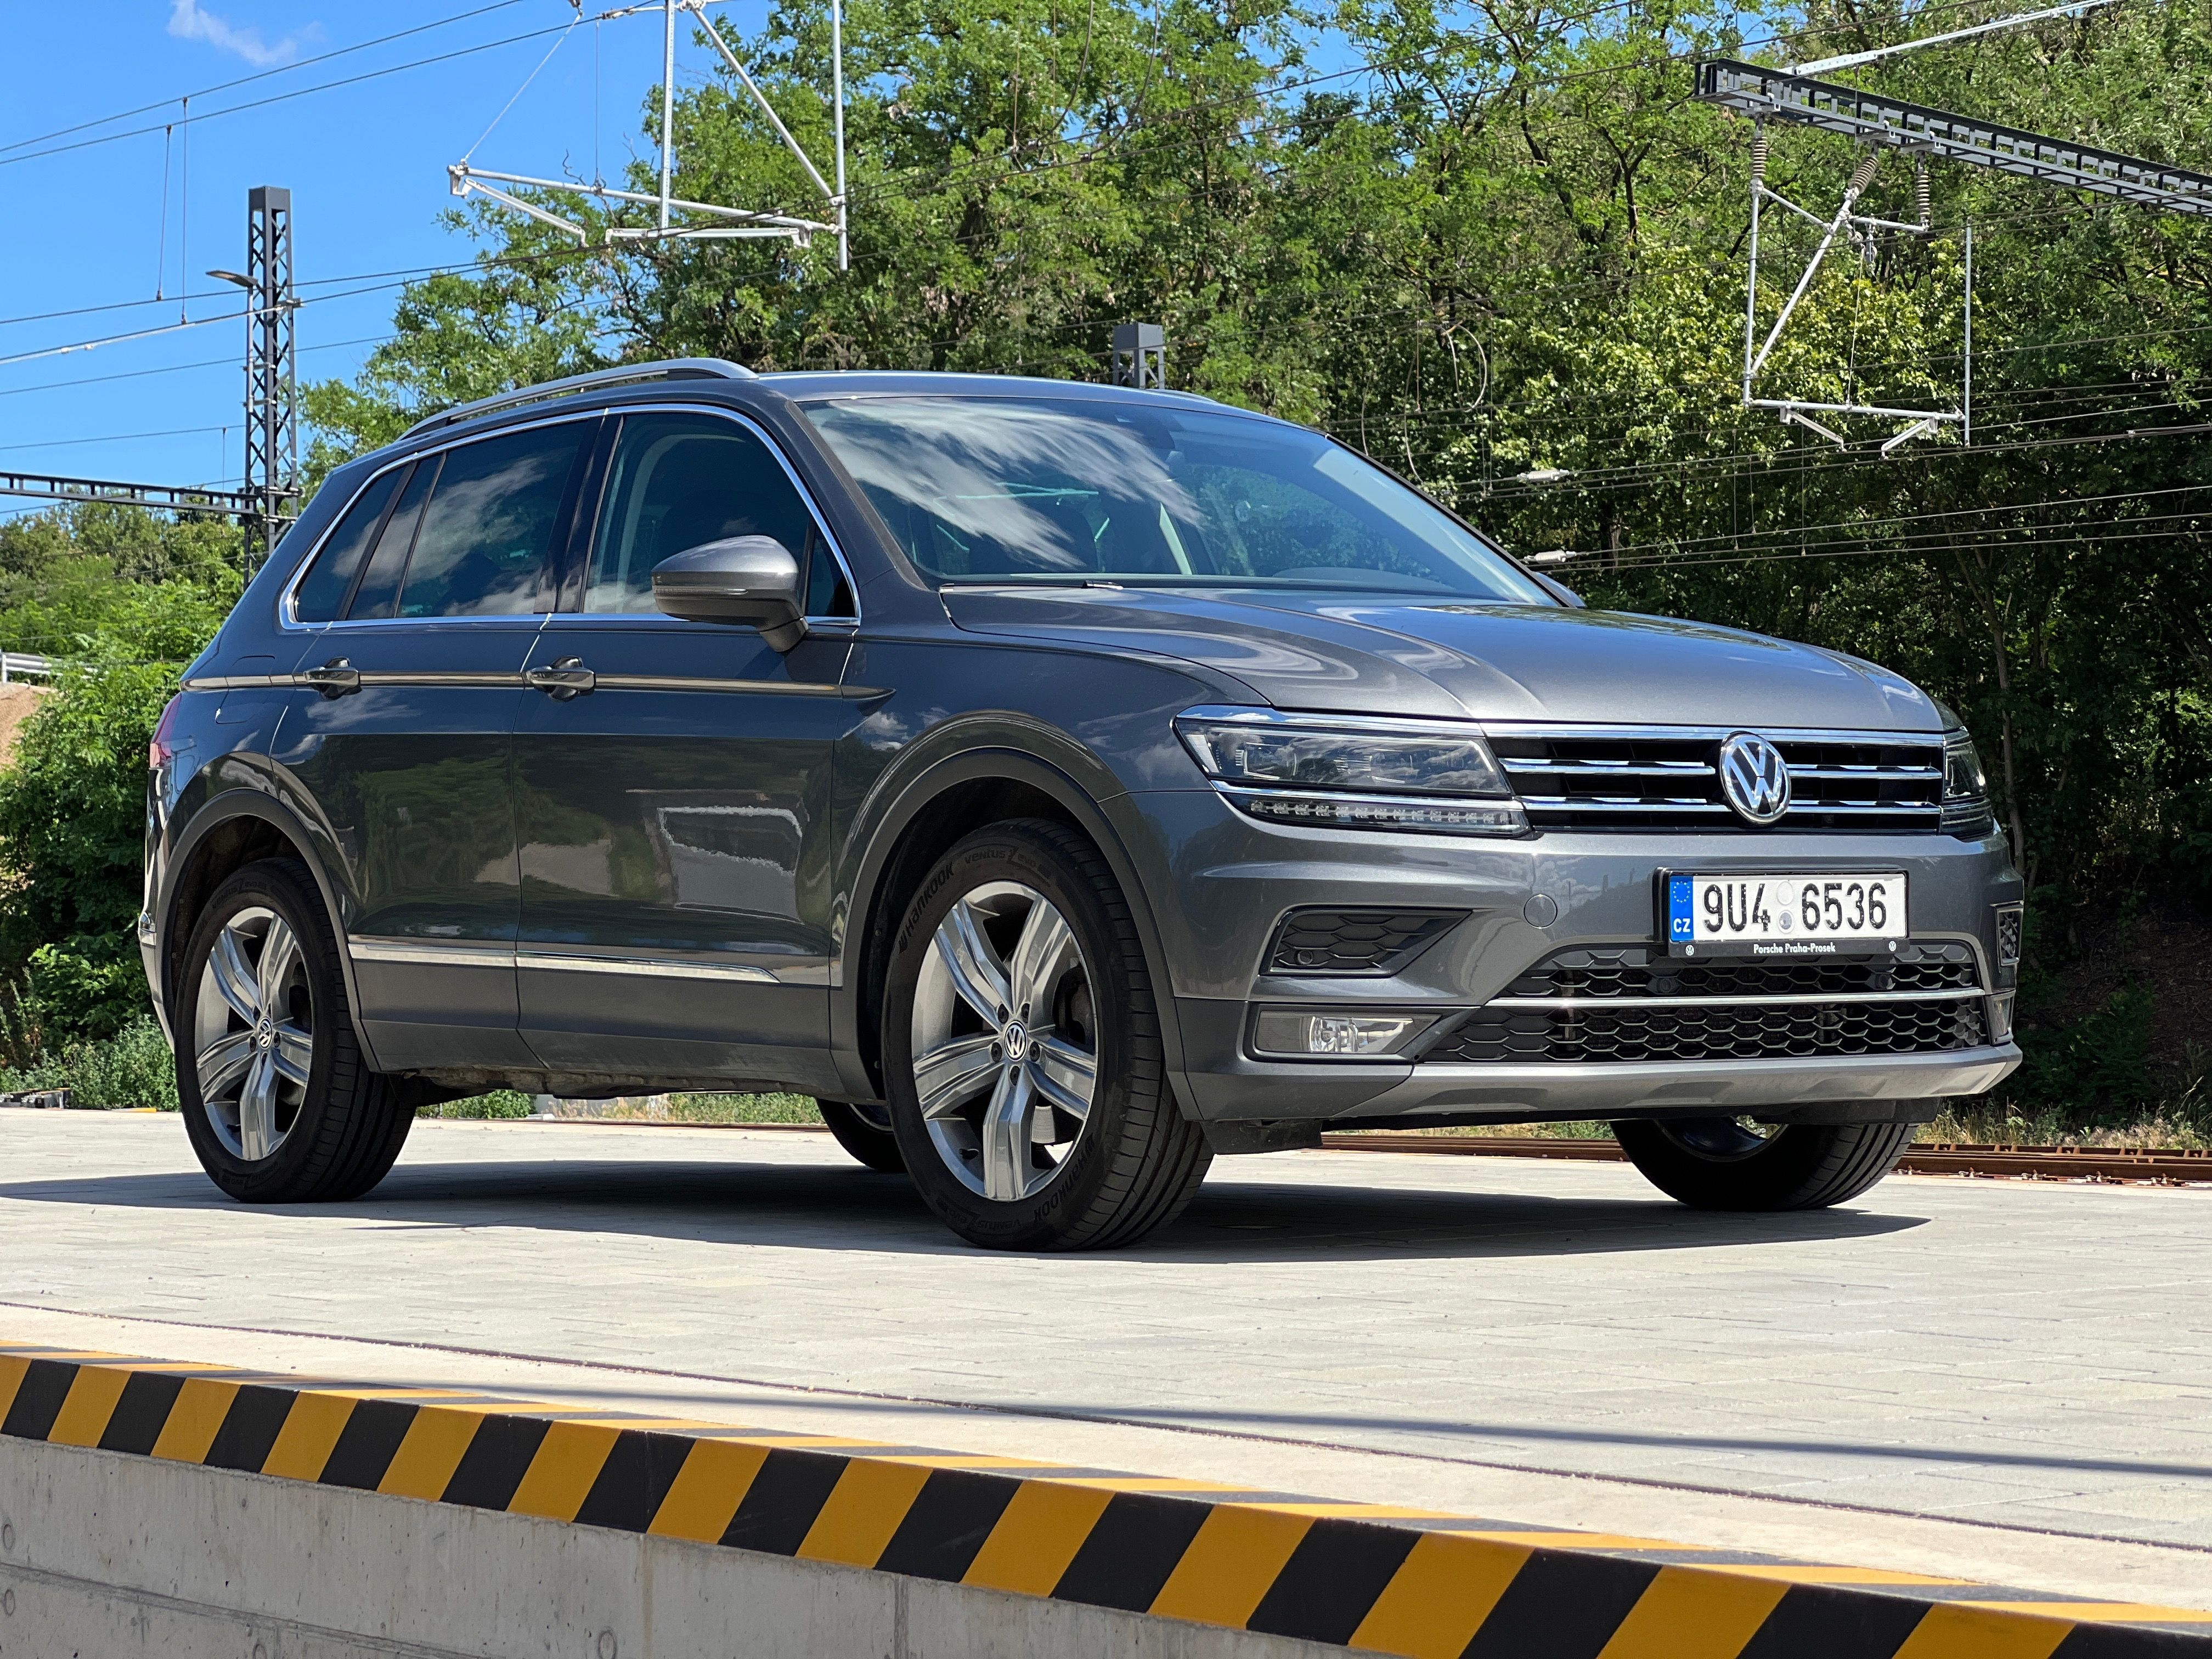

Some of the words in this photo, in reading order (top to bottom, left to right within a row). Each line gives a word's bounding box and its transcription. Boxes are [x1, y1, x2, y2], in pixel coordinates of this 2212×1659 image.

[1722, 734, 1790, 822] VW
[1703, 883, 1771, 933] 9U4
[1802, 882, 1887, 931] 6536
[1673, 918, 1691, 933] CZ
[1685, 945, 1695, 956] VW
[1753, 943, 1784, 954] Porsche
[1785, 941, 1836, 953] Praha-Prosek
[1005, 1022, 1027, 1060] VW
